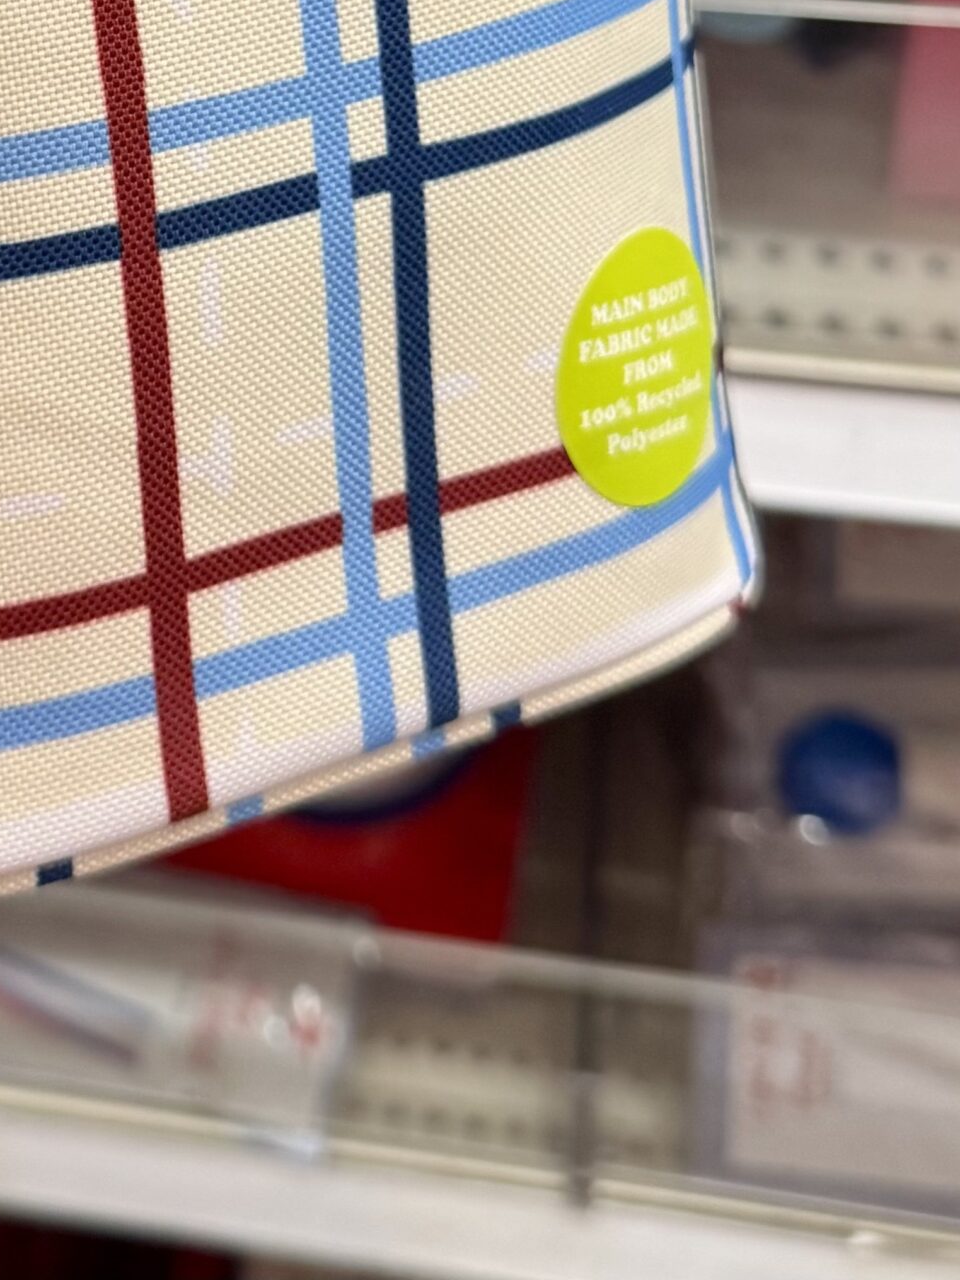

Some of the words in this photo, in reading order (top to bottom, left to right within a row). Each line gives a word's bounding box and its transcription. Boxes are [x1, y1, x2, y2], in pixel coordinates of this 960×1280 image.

[591, 293, 644, 324] MAIN
[648, 278, 689, 310] BODY
[579, 326, 652, 363] FABRIC
[656, 307, 698, 340] MADE
[623, 350, 674, 385] FROM
[579, 398, 632, 429] 100%
[636, 371, 702, 413] Recycled
[606, 415, 688, 455] Polyester
